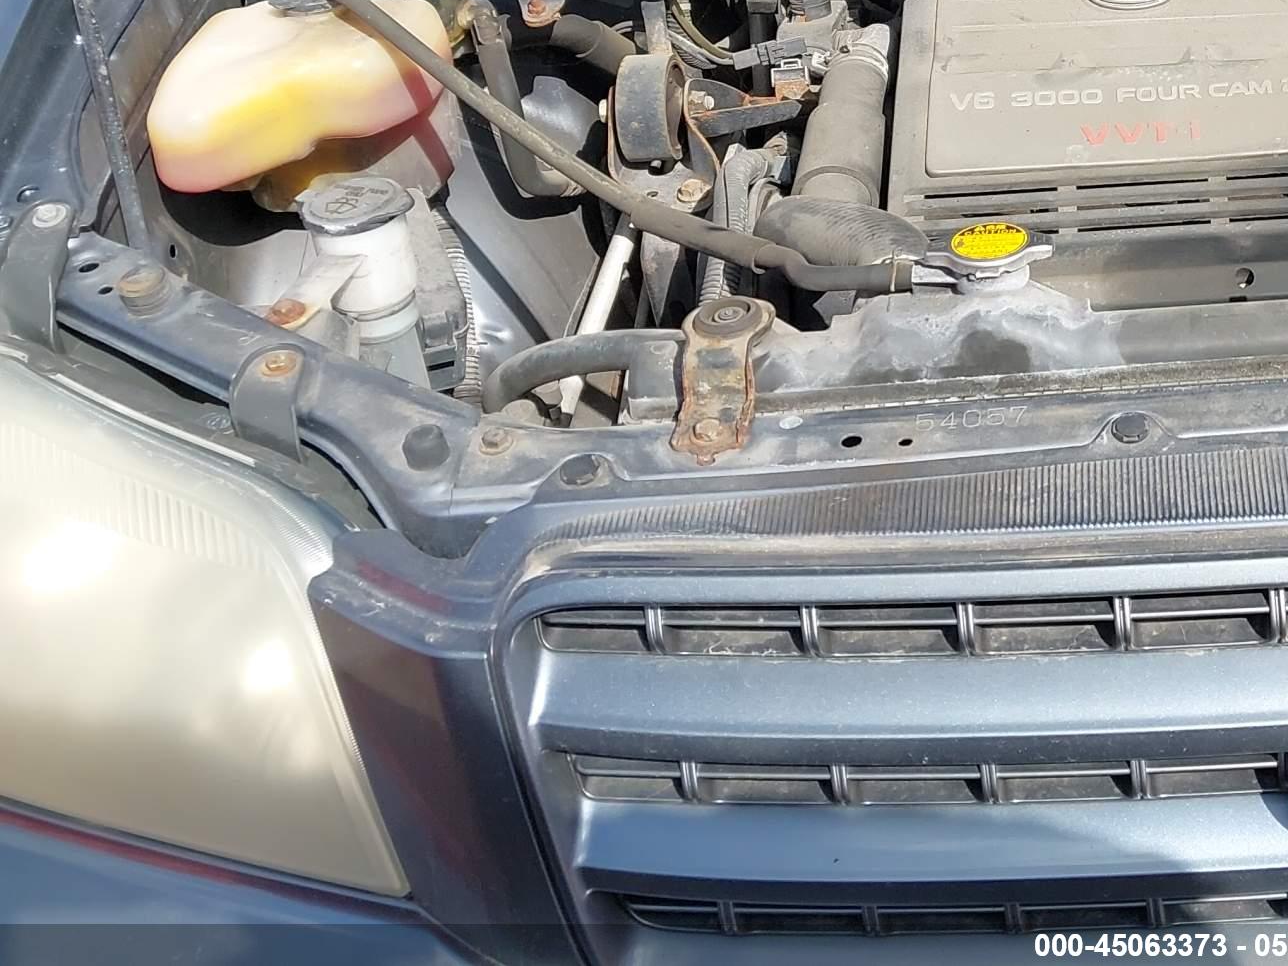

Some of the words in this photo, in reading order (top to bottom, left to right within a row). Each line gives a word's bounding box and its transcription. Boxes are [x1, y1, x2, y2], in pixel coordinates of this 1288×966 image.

[949, 90, 995, 111] V6
[1010, 89, 1103, 107] 3000
[1116, 84, 1202, 103] FOUR
[1208, 80, 1273, 98] CAM
[964, 228, 1017, 236] CAUTION
[915, 405, 1029, 432] 54057
